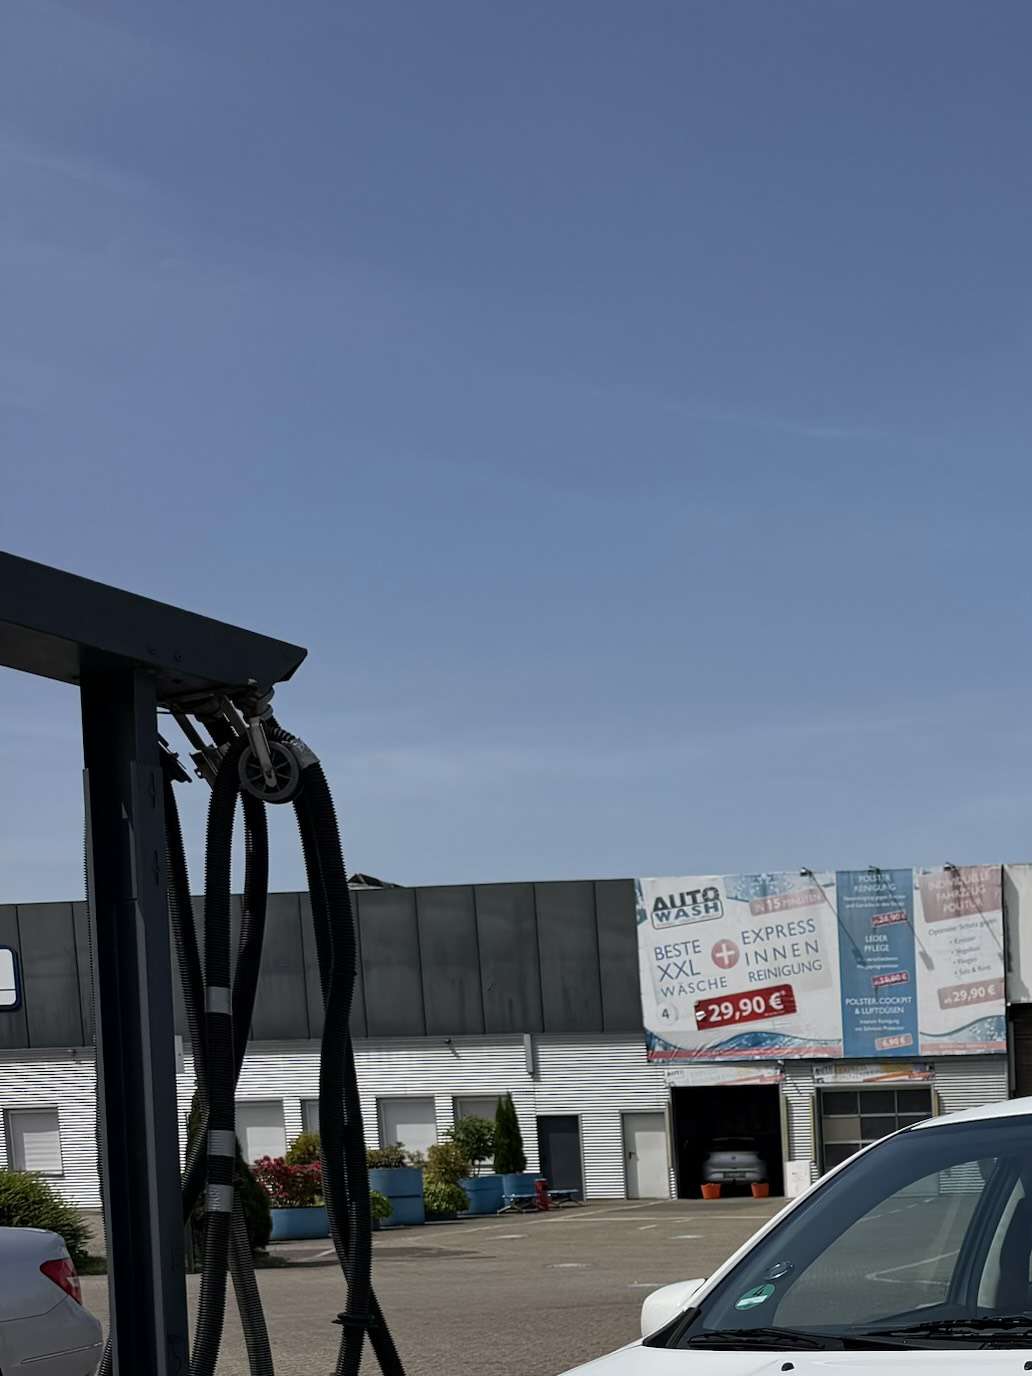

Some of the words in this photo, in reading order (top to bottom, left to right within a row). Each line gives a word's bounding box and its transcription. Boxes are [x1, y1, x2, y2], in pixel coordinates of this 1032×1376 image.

[653, 886, 720, 912] AUTO
[655, 902, 719, 922] WASH
[741, 918, 816, 945] EXPRESS
[654, 939, 702, 961] BESTE
[745, 939, 819, 967] INNEN
[657, 959, 701, 982] XXL
[748, 959, 823, 982] REINIGUNG
[708, 996, 766, 1022] 29,90
